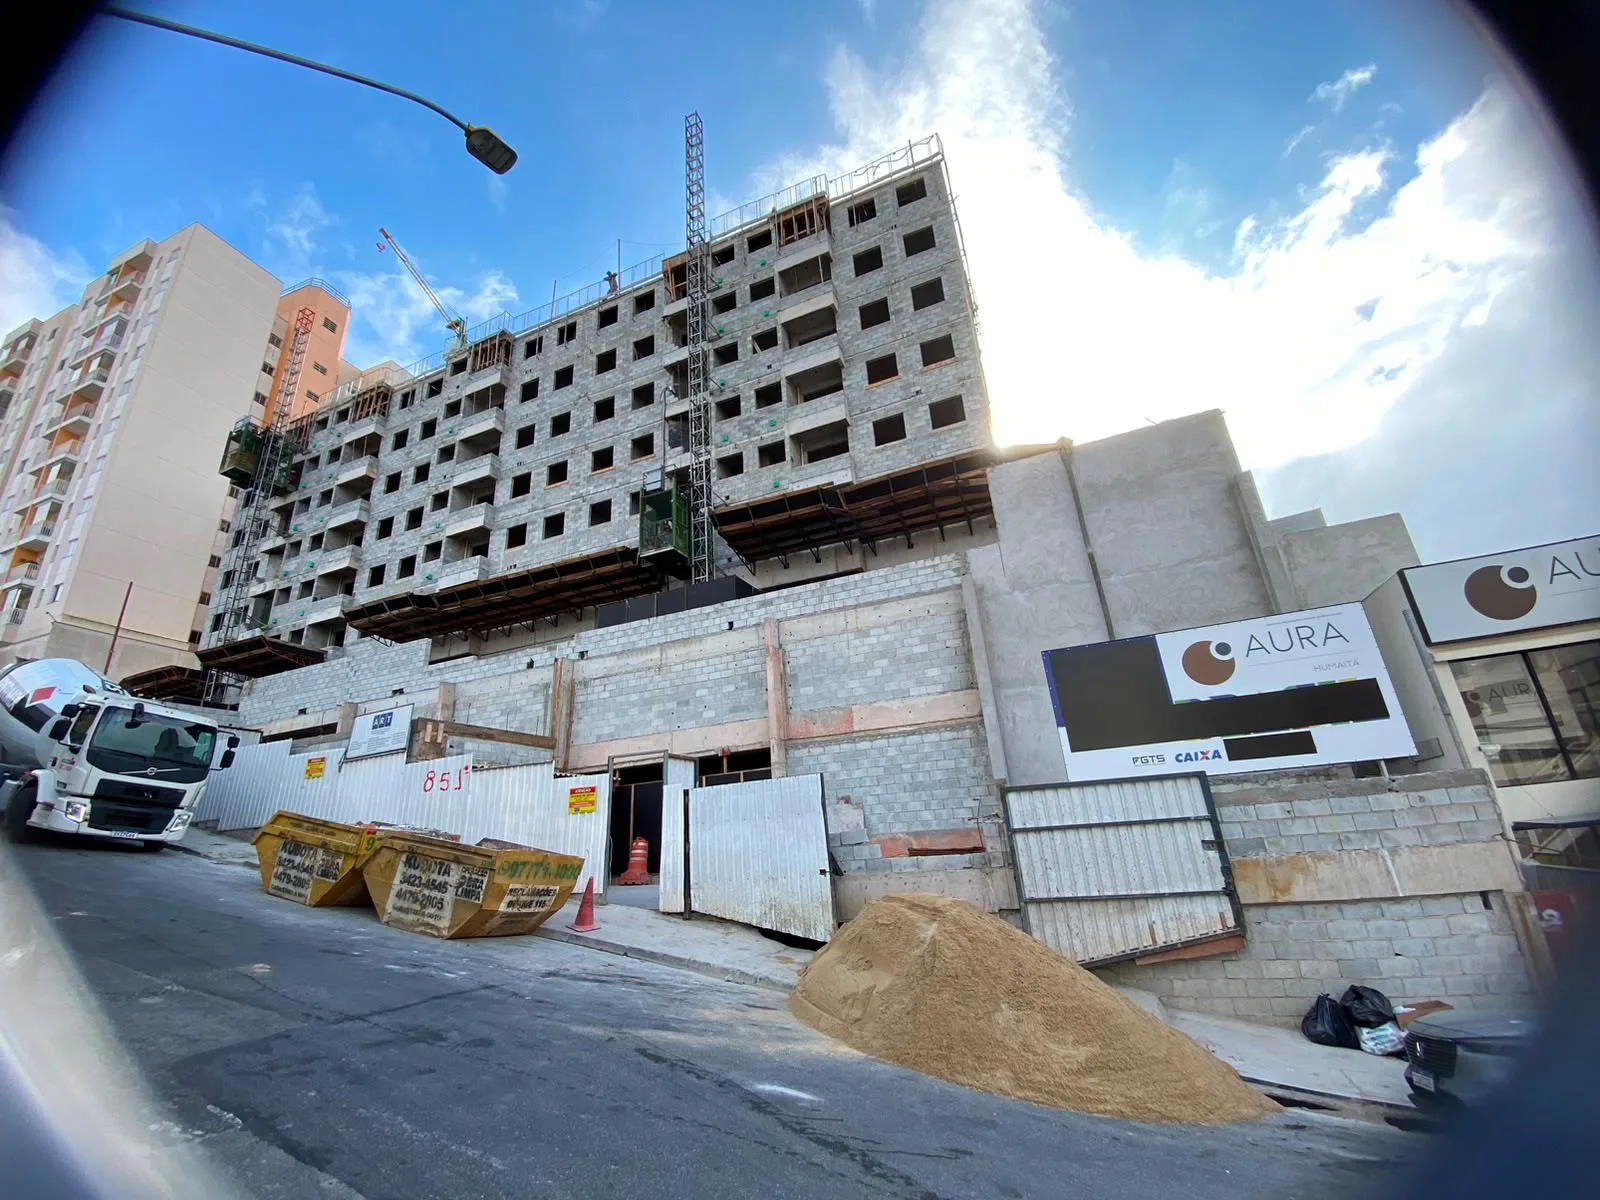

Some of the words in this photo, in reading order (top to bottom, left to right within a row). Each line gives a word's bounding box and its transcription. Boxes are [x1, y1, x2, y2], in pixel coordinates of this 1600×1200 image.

[1245, 622, 1350, 658] AURA
[373, 713, 393, 729] ART
[1132, 754, 1166, 765] FGTS
[1175, 749, 1223, 764] CAIXA
[281, 839, 319, 861] KUBOTA
[404, 854, 451, 878] KUBOTA
[400, 872, 449, 895] 3423-4545
[395, 888, 444, 911] 4479-2805
[455, 888, 481, 902] LIMPA
[534, 899, 547, 909] 115
